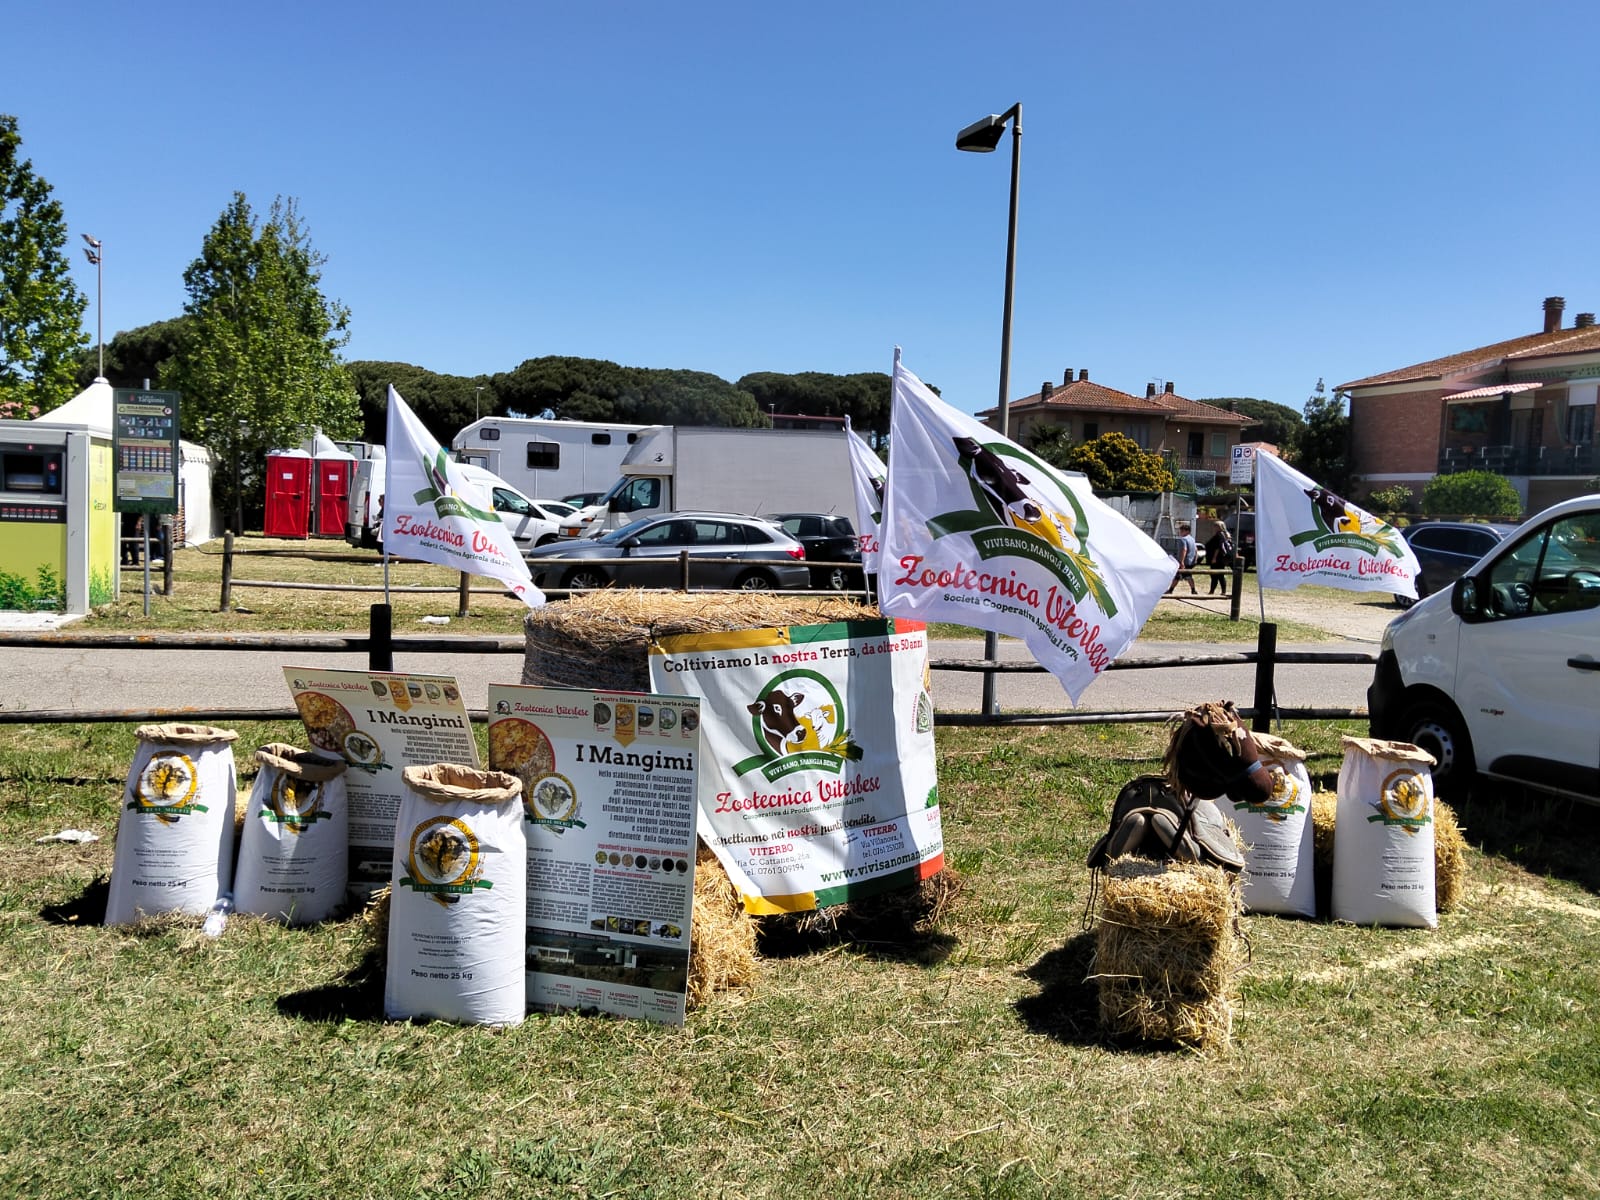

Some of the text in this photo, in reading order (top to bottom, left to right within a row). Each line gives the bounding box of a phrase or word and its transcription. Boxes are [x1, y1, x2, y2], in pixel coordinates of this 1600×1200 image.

[983, 537, 1006, 549] VIVI
[1004, 537, 1030, 552] SANO,
[1030, 543, 1063, 567] MANGIA
[1274, 553, 1352, 572] Zootecnica
[895, 555, 1110, 674] Zootecnica Viterbese
[943, 593, 981, 606] Società
[983, 598, 1036, 623] Cooperativa
[663, 638, 923, 674] Coltiviamo la nostra Terra, da oltre 50 anni
[514, 702, 554, 714] Zootecnica
[556, 704, 589, 717] Viterbese
[366, 709, 465, 729] I Mangimi
[576, 744, 693, 772] I Mangimi
[612, 771, 645, 781] stabilimento
[768, 766, 783, 776] VIVI
[653, 783, 676, 792] mangimi
[676, 785, 692, 793] adatti
[715, 773, 881, 814] Zootecnica Viterbese
[608, 796, 621, 805] degli
[658, 792, 671, 801] degli
[672, 794, 692, 802] animali
[782, 808, 790, 816] di
[613, 814, 636, 824] mangimi
[770, 828, 785, 840] nei
[787, 823, 819, 838] nostri
[820, 818, 843, 836] punti
[843, 813, 876, 828] vendita
[862, 823, 898, 838] VITERBO
[608, 830, 641, 841] direttamente
[657, 835, 688, 846] Cooperativa
[861, 840, 871, 849] Via
[749, 843, 794, 857] VITERBO
[862, 850, 872, 859] tel.
[872, 846, 886, 856] 0761
[749, 858, 758, 866] C.
[759, 856, 796, 866] Cattaneo,
[757, 865, 776, 876] 0761
[777, 863, 805, 874] 309194
[260, 885, 276, 893] Peso
[411, 968, 473, 981] Peso netto 25 kg
